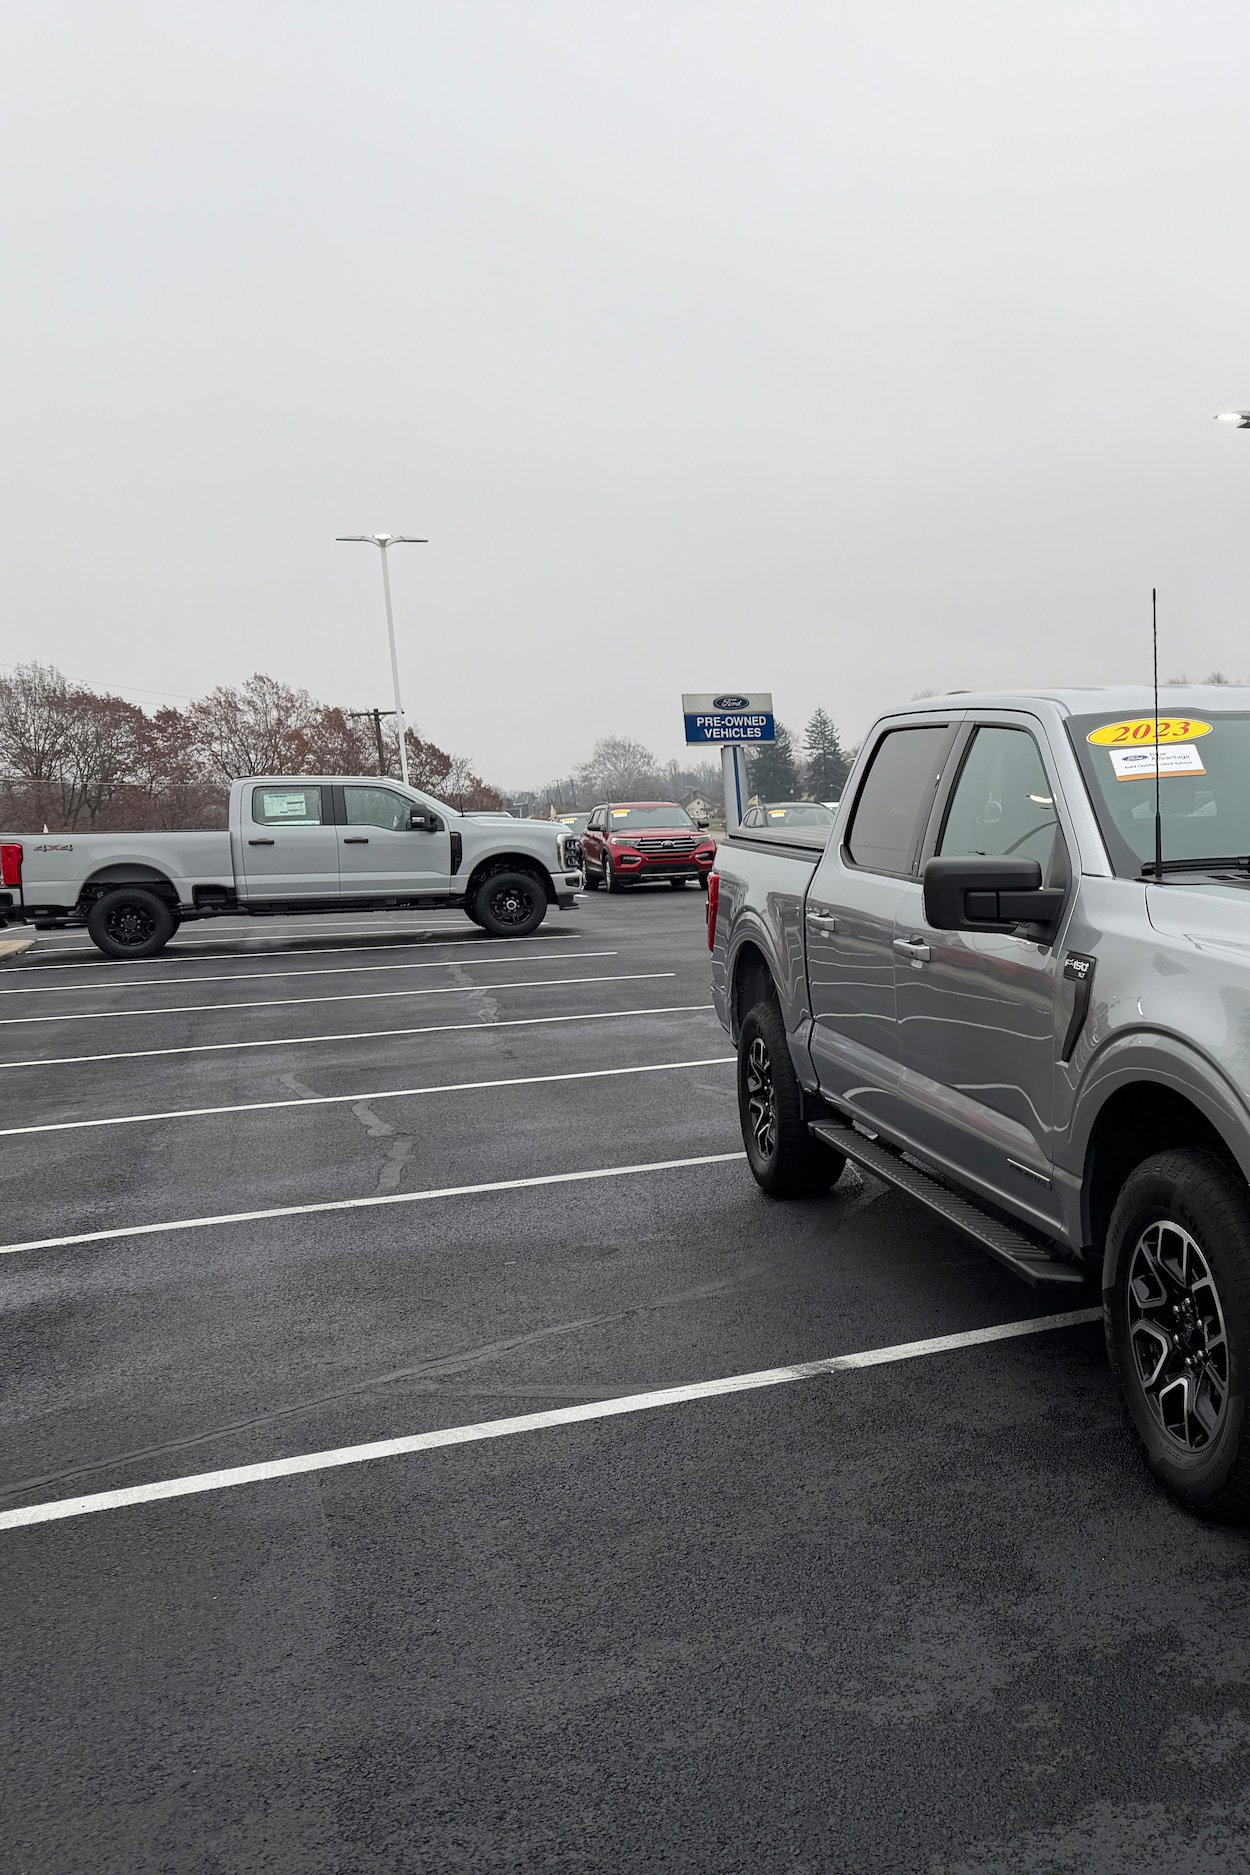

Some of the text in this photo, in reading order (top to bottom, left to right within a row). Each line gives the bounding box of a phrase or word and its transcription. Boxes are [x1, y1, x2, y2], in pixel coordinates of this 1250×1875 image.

[721, 698, 743, 708] Ford
[696, 715, 767, 727] PRE-OWNED
[704, 727, 762, 738] VEHICLES
[1111, 721, 1191, 743] 2023
